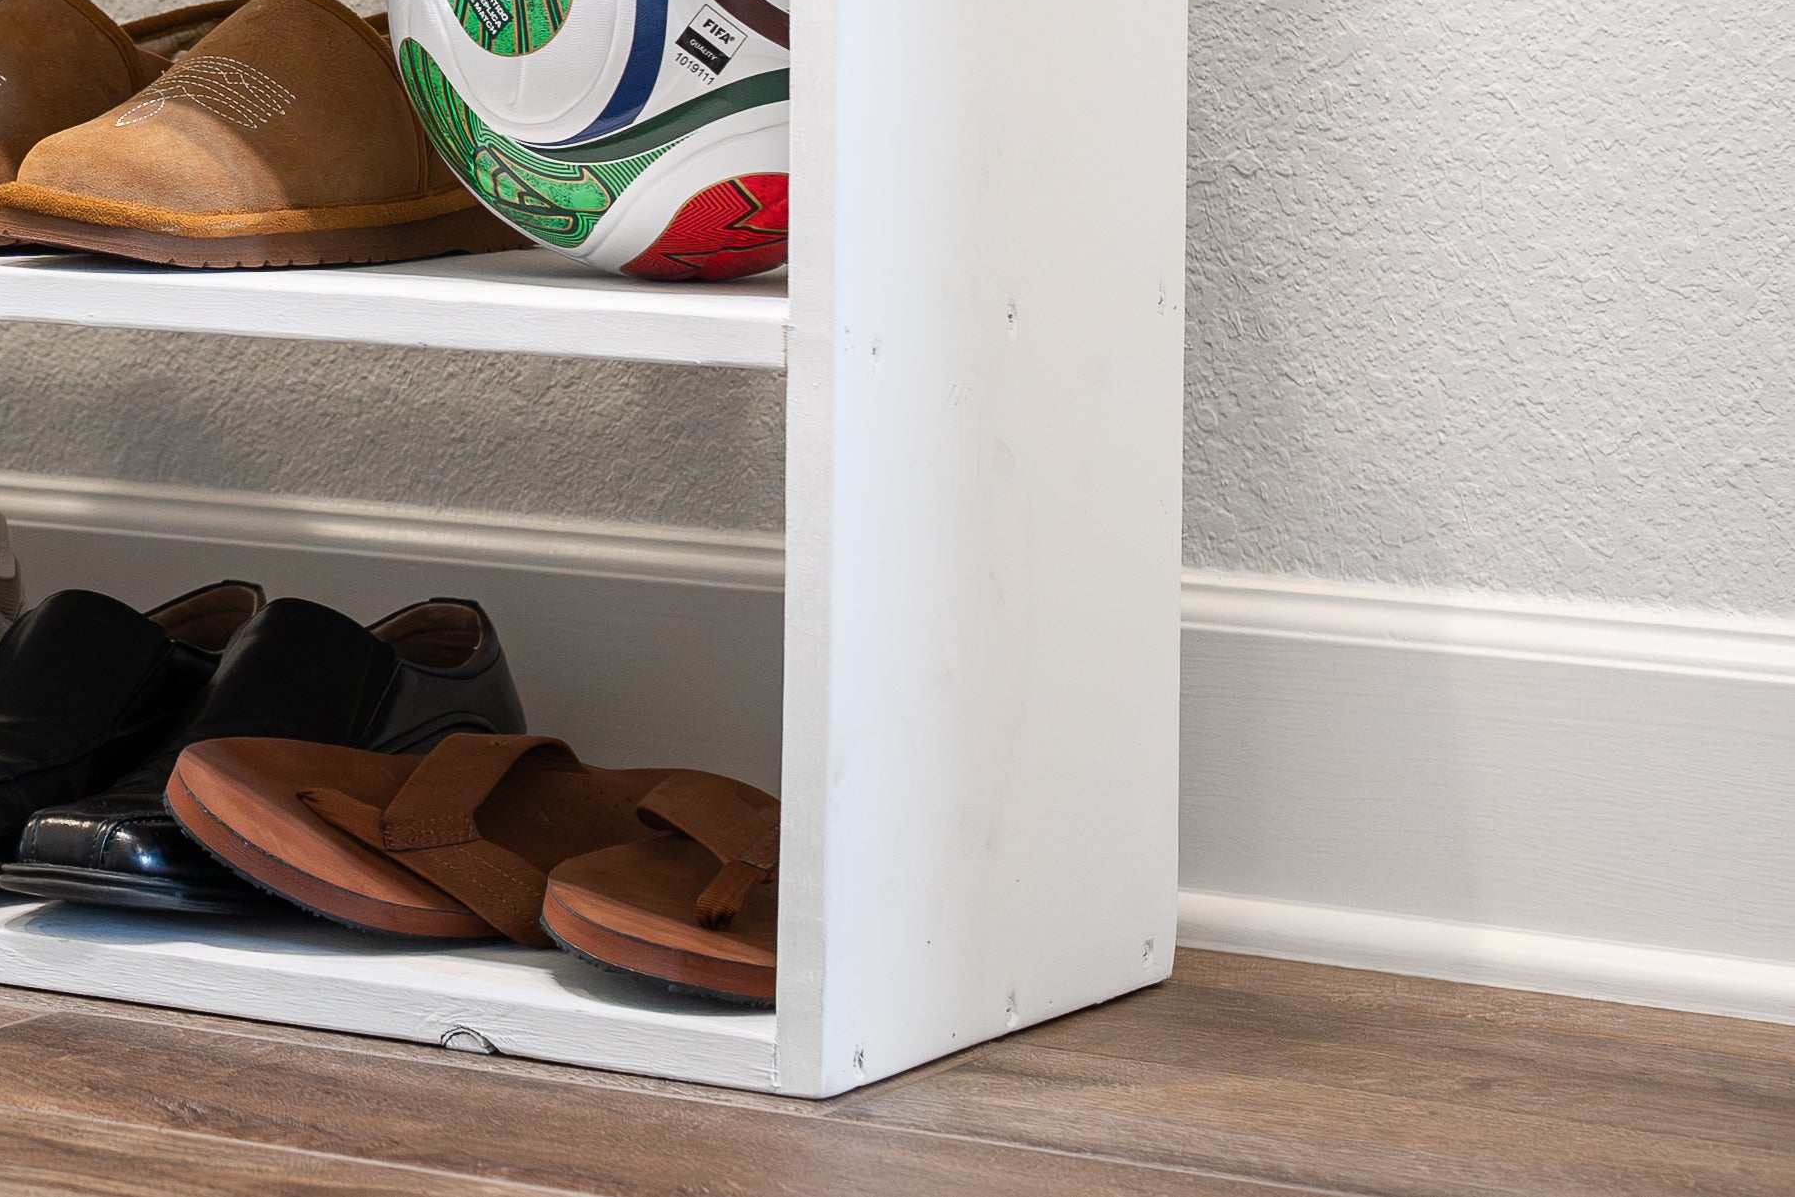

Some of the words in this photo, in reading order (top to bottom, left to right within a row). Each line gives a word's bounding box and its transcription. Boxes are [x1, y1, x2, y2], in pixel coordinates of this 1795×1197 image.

[474, 1, 497, 35] MATCH
[689, 38, 718, 61] QUALITY
[675, 52, 715, 85] 1019111
